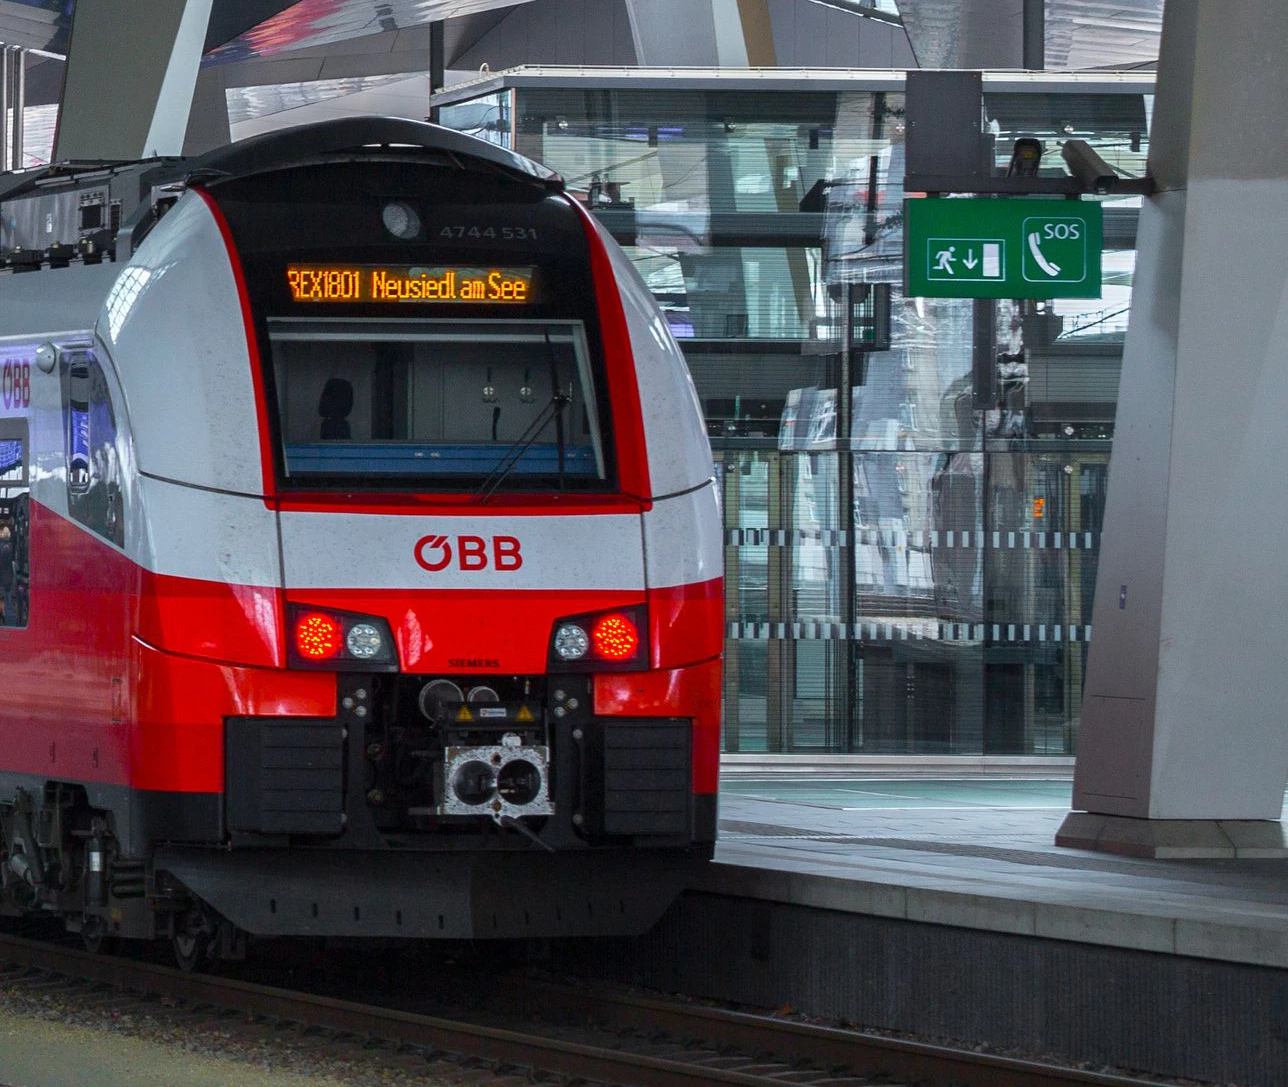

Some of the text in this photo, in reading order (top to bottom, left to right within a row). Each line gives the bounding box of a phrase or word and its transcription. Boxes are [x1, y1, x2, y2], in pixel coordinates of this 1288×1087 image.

[440, 226, 537, 240] 4744 531
[1044, 223, 1080, 240] SOS
[372, 270, 456, 299] Neusiedl
[460, 281, 485, 299] am
[488, 272, 526, 300] See
[2, 358, 31, 409] ÖBB
[414, 534, 523, 572] ÖBB
[447, 659, 500, 669] SIEMENS
